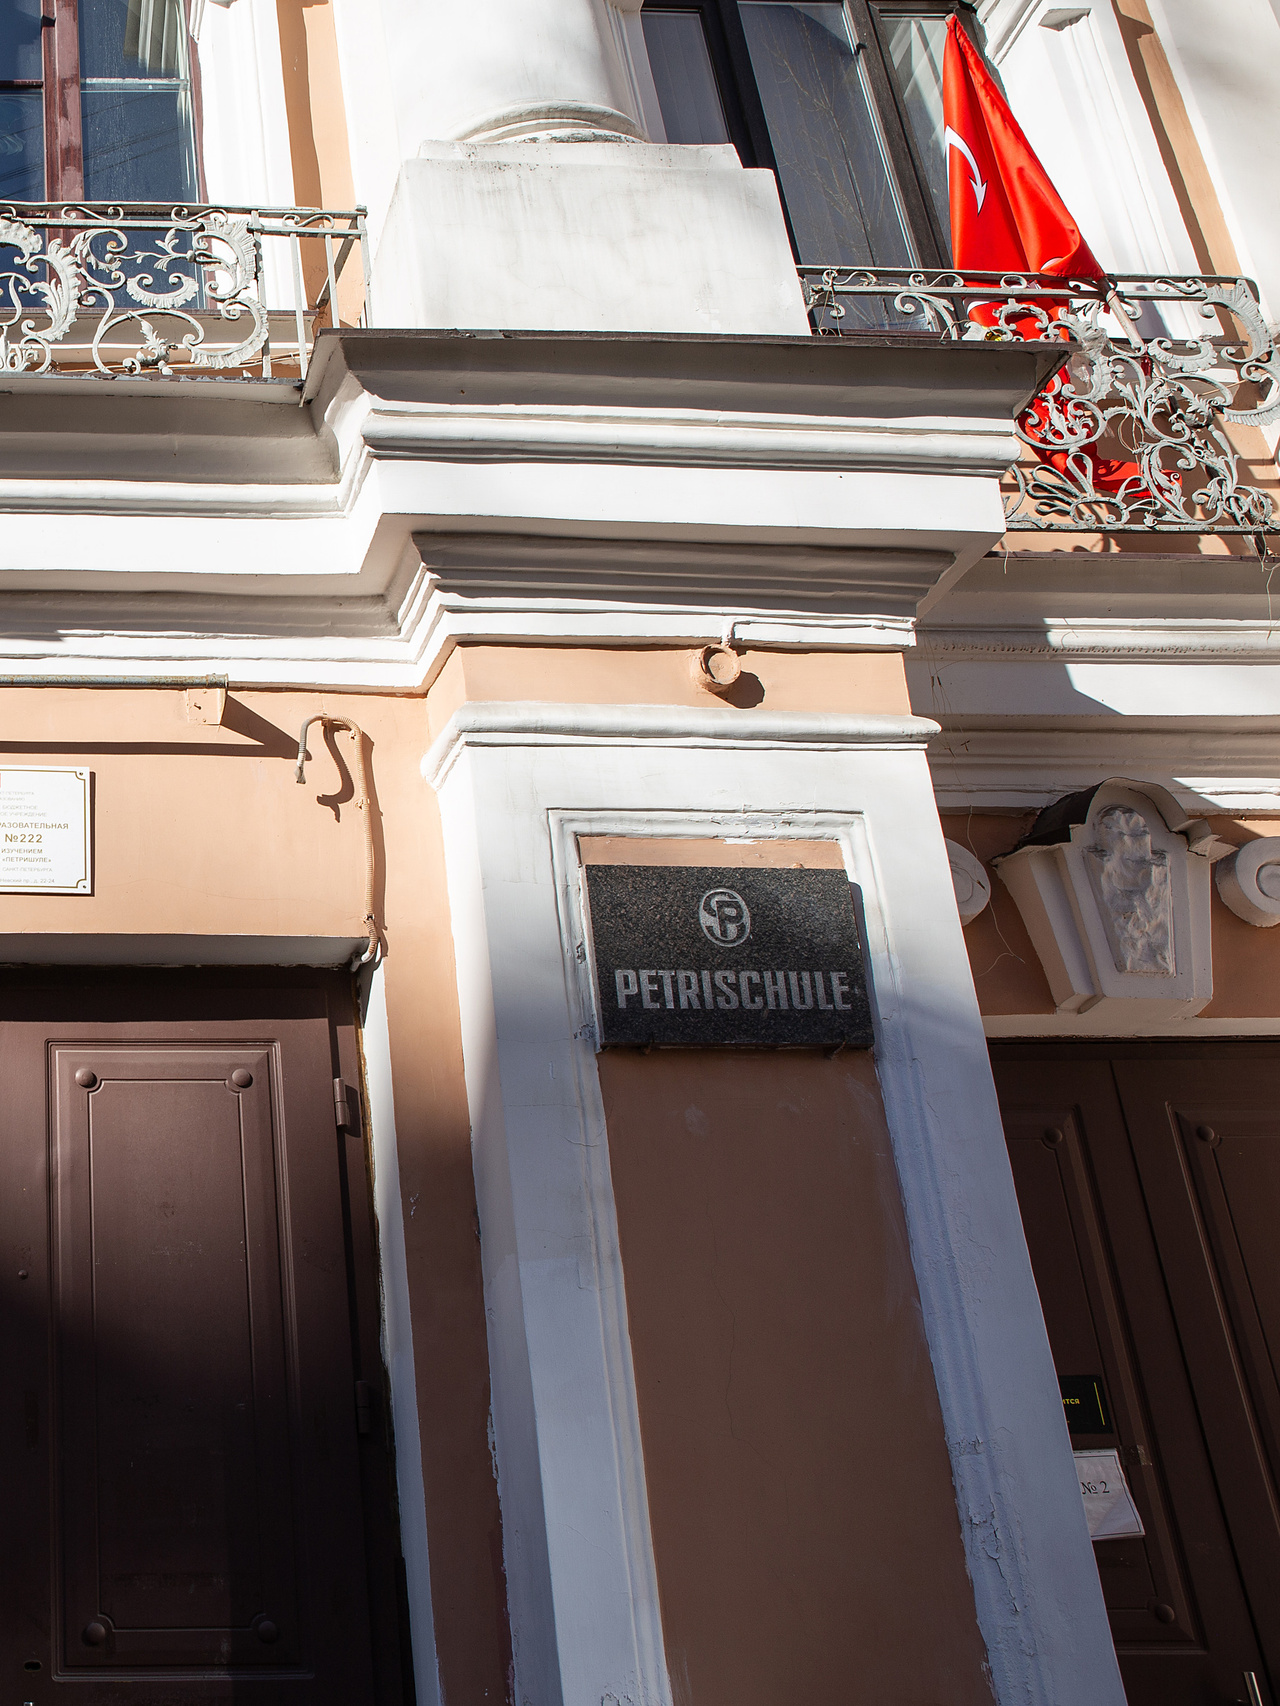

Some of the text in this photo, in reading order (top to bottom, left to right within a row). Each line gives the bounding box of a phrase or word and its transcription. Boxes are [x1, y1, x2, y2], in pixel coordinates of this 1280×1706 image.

[4, 833, 43, 844] №222
[614, 969, 852, 1010] PETRISCHULE
[1100, 1480, 1110, 1494] 2
